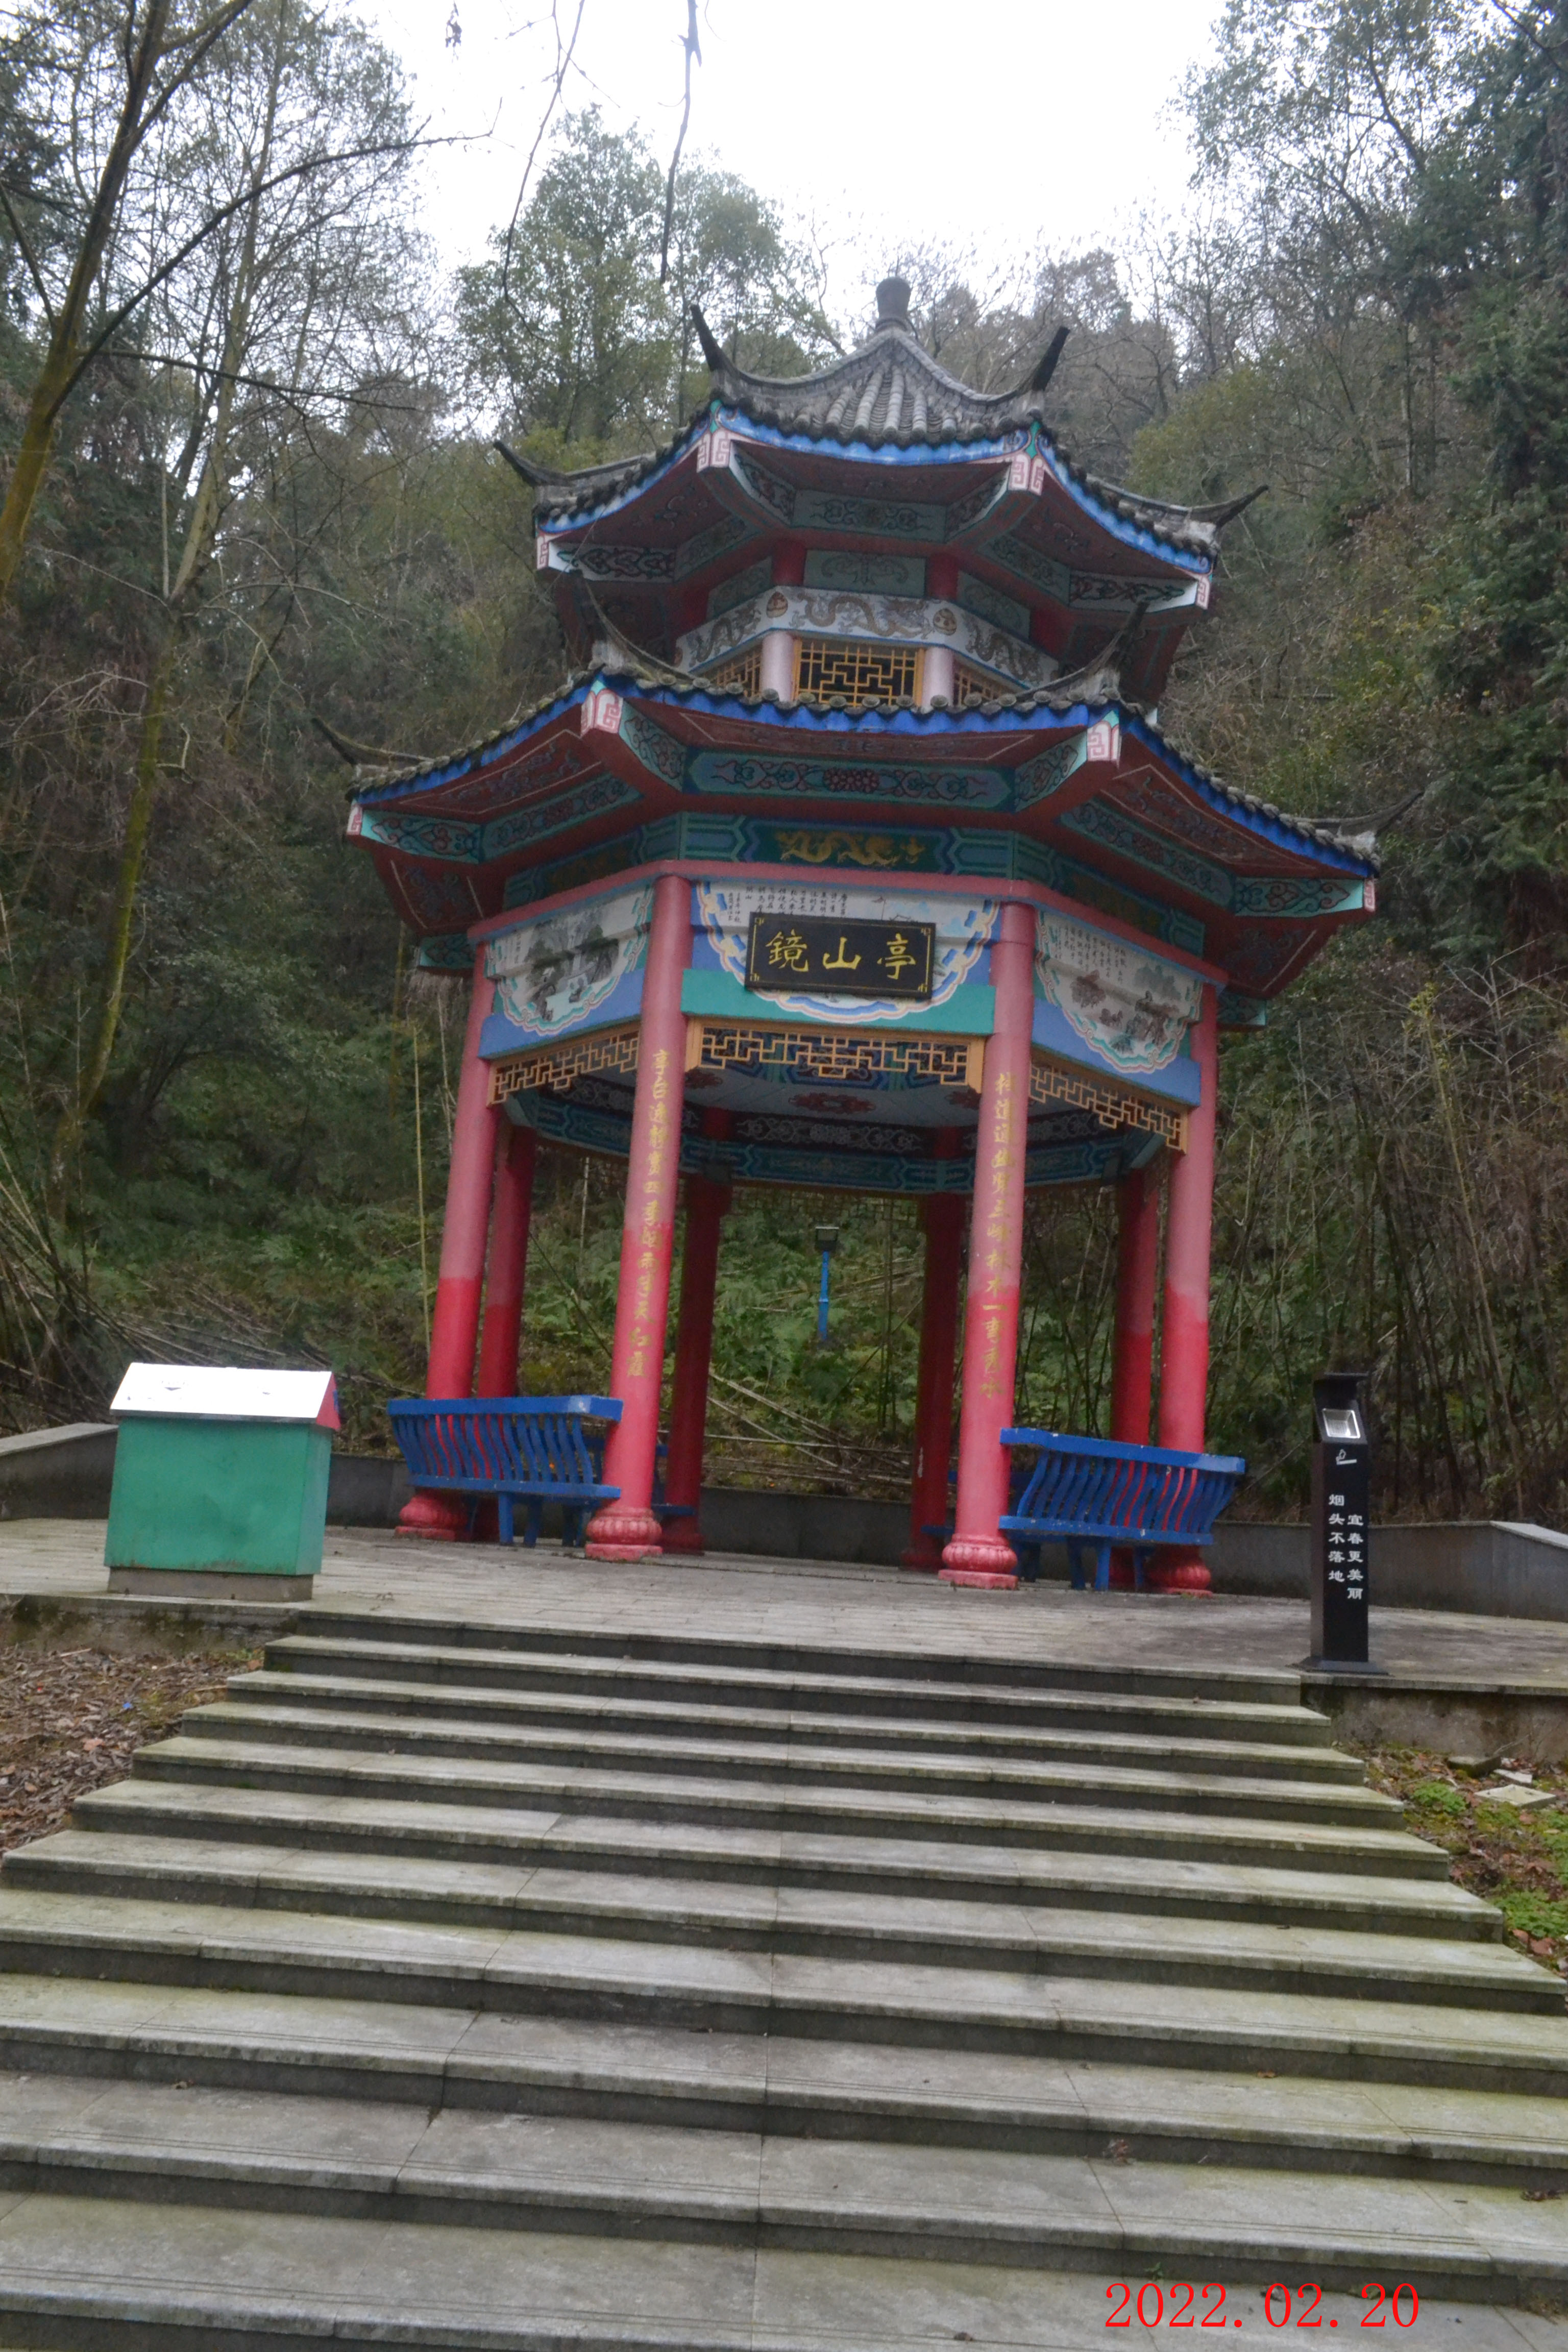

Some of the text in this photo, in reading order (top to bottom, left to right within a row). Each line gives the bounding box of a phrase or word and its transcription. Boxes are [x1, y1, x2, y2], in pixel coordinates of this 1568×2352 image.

[766, 929, 916, 980] 鏡山亭
[1328, 1493, 1345, 1583] 烟头不落地
[1346, 1513, 1364, 1600] 宜春更美丽
